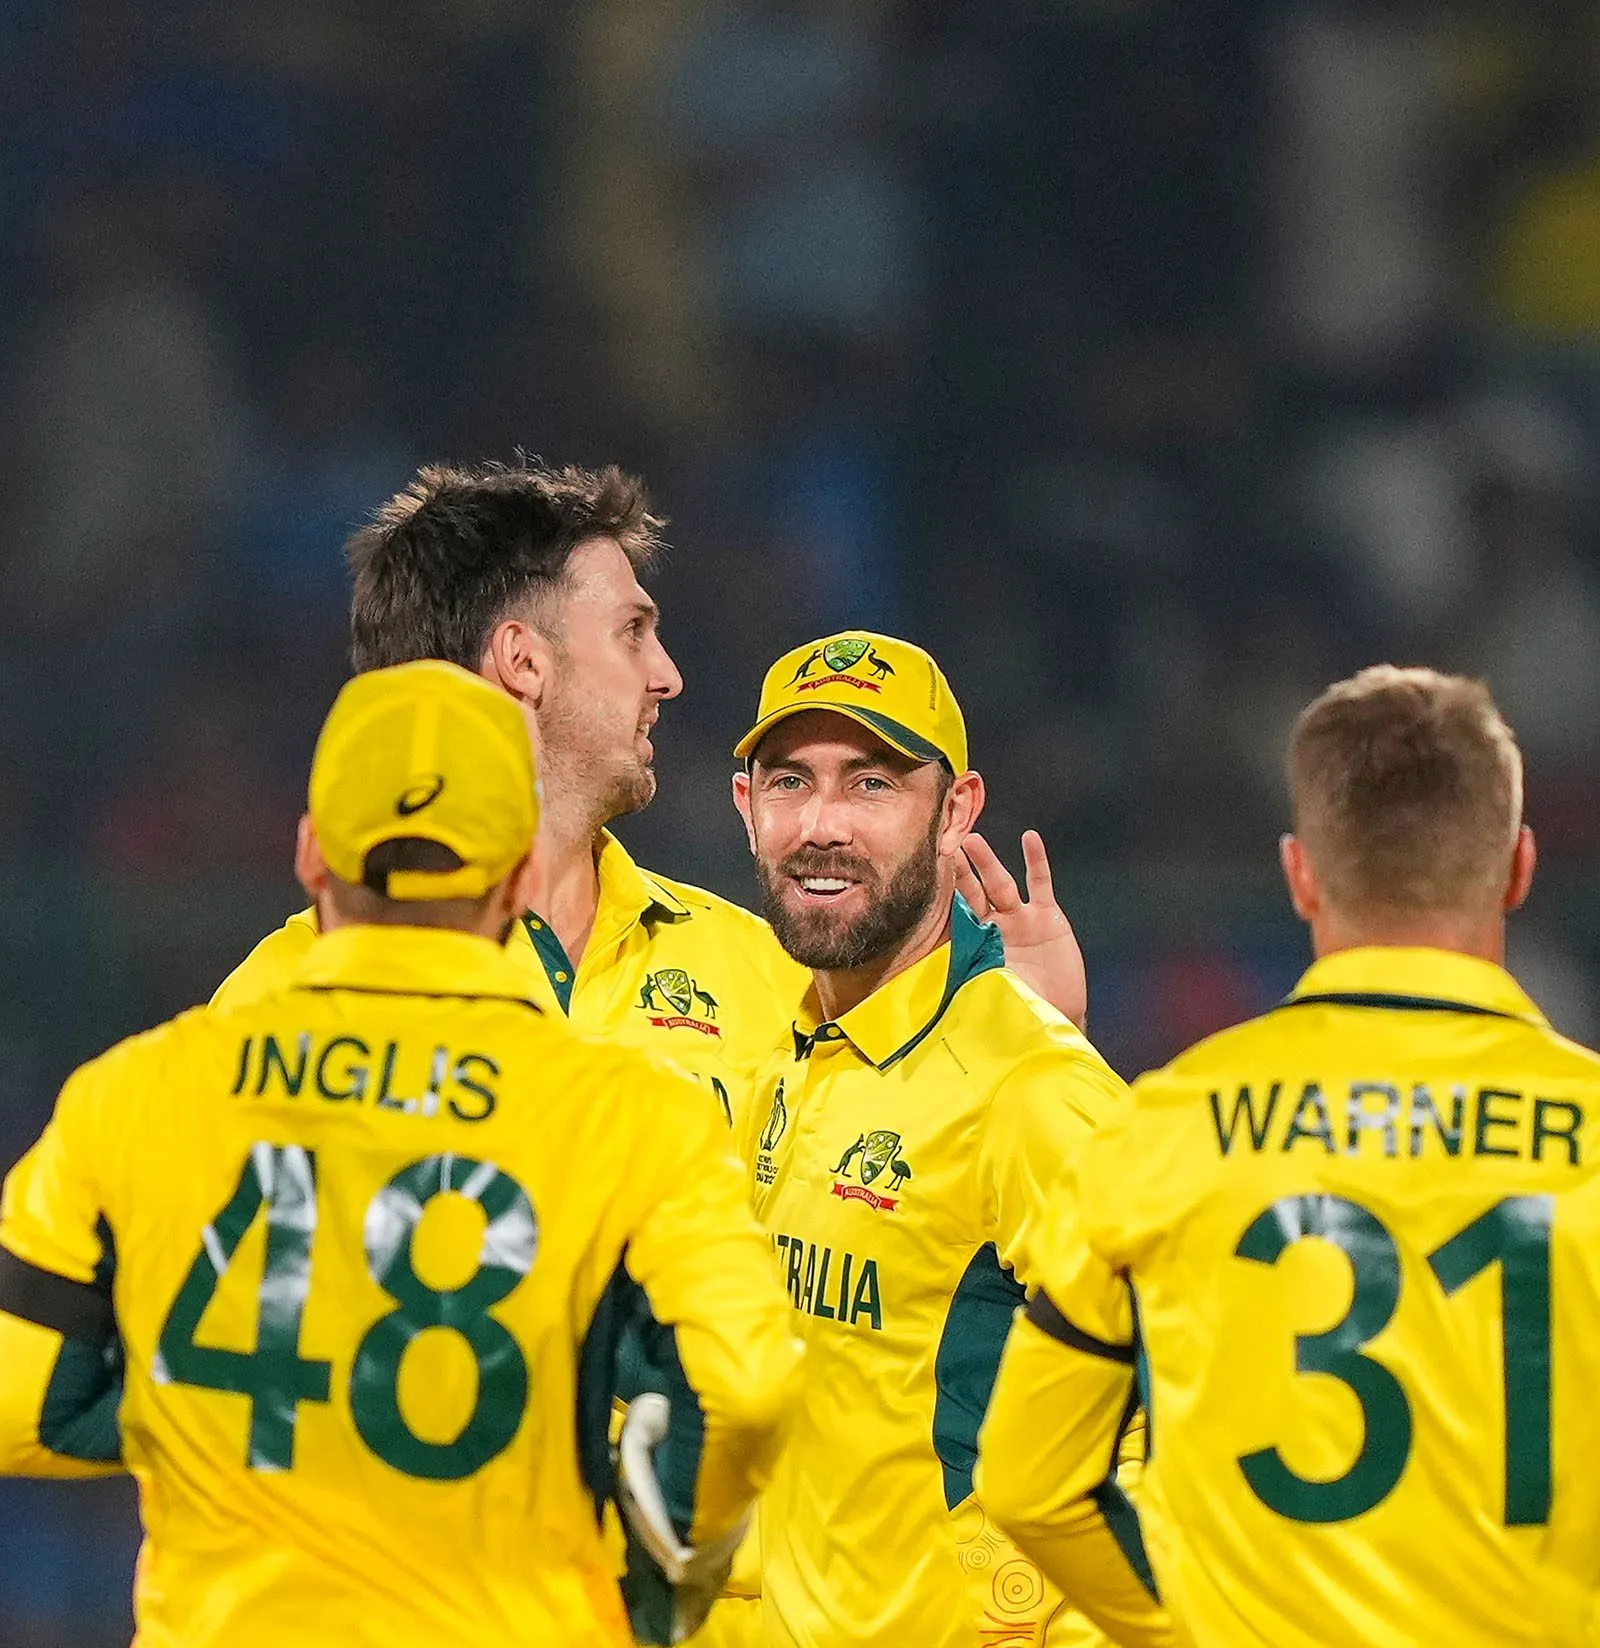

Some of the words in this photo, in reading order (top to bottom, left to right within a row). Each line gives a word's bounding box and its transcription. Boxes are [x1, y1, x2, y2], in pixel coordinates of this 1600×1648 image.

[231, 1031, 502, 1123] INGLIS
[1208, 1081, 1584, 1167] WARNER
[152, 1139, 540, 1483] 48
[771, 1232, 882, 1331] TRALIA
[1233, 1191, 1557, 1528] 31
